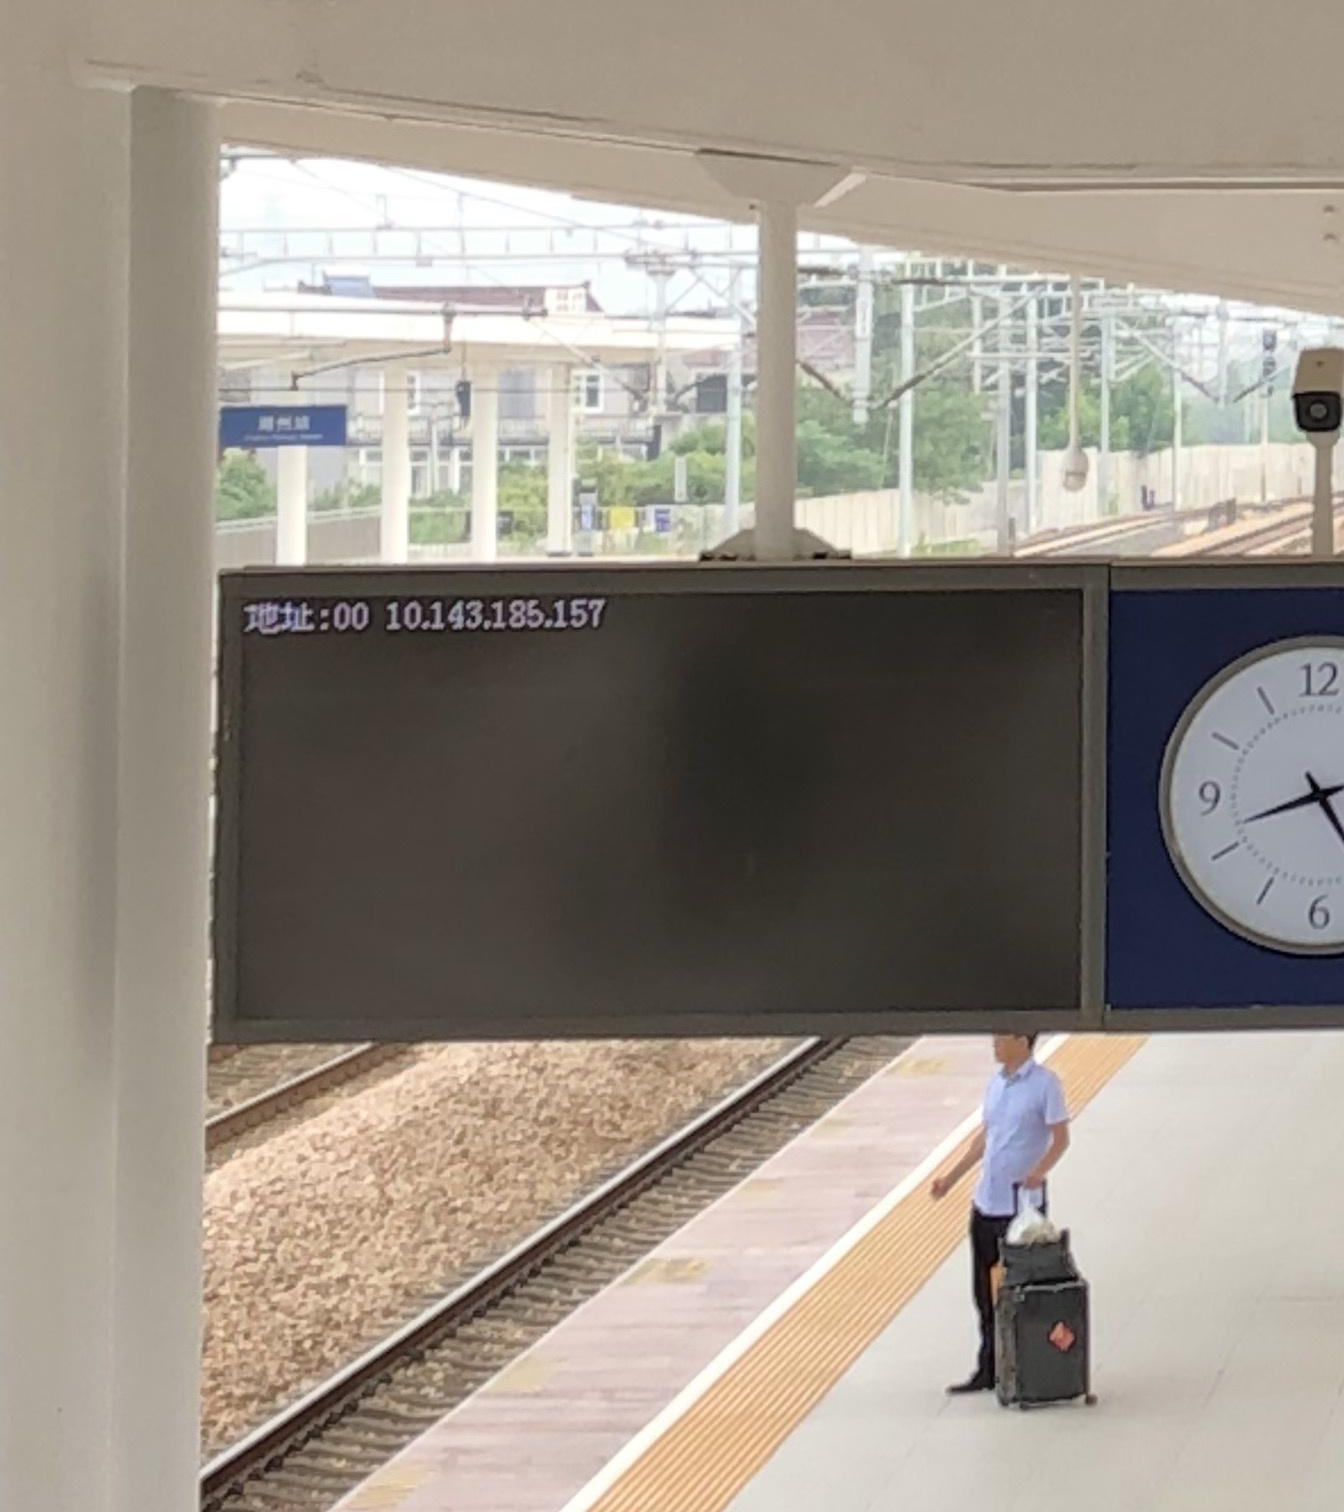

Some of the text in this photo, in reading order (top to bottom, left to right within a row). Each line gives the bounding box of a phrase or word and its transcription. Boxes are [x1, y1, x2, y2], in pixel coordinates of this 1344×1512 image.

[244, 599, 605, 634] 地址:00 10.143.185.157
[1299, 662, 1339, 697] 12
[1199, 781, 1221, 816] 9
[1308, 896, 1331, 930] 6
